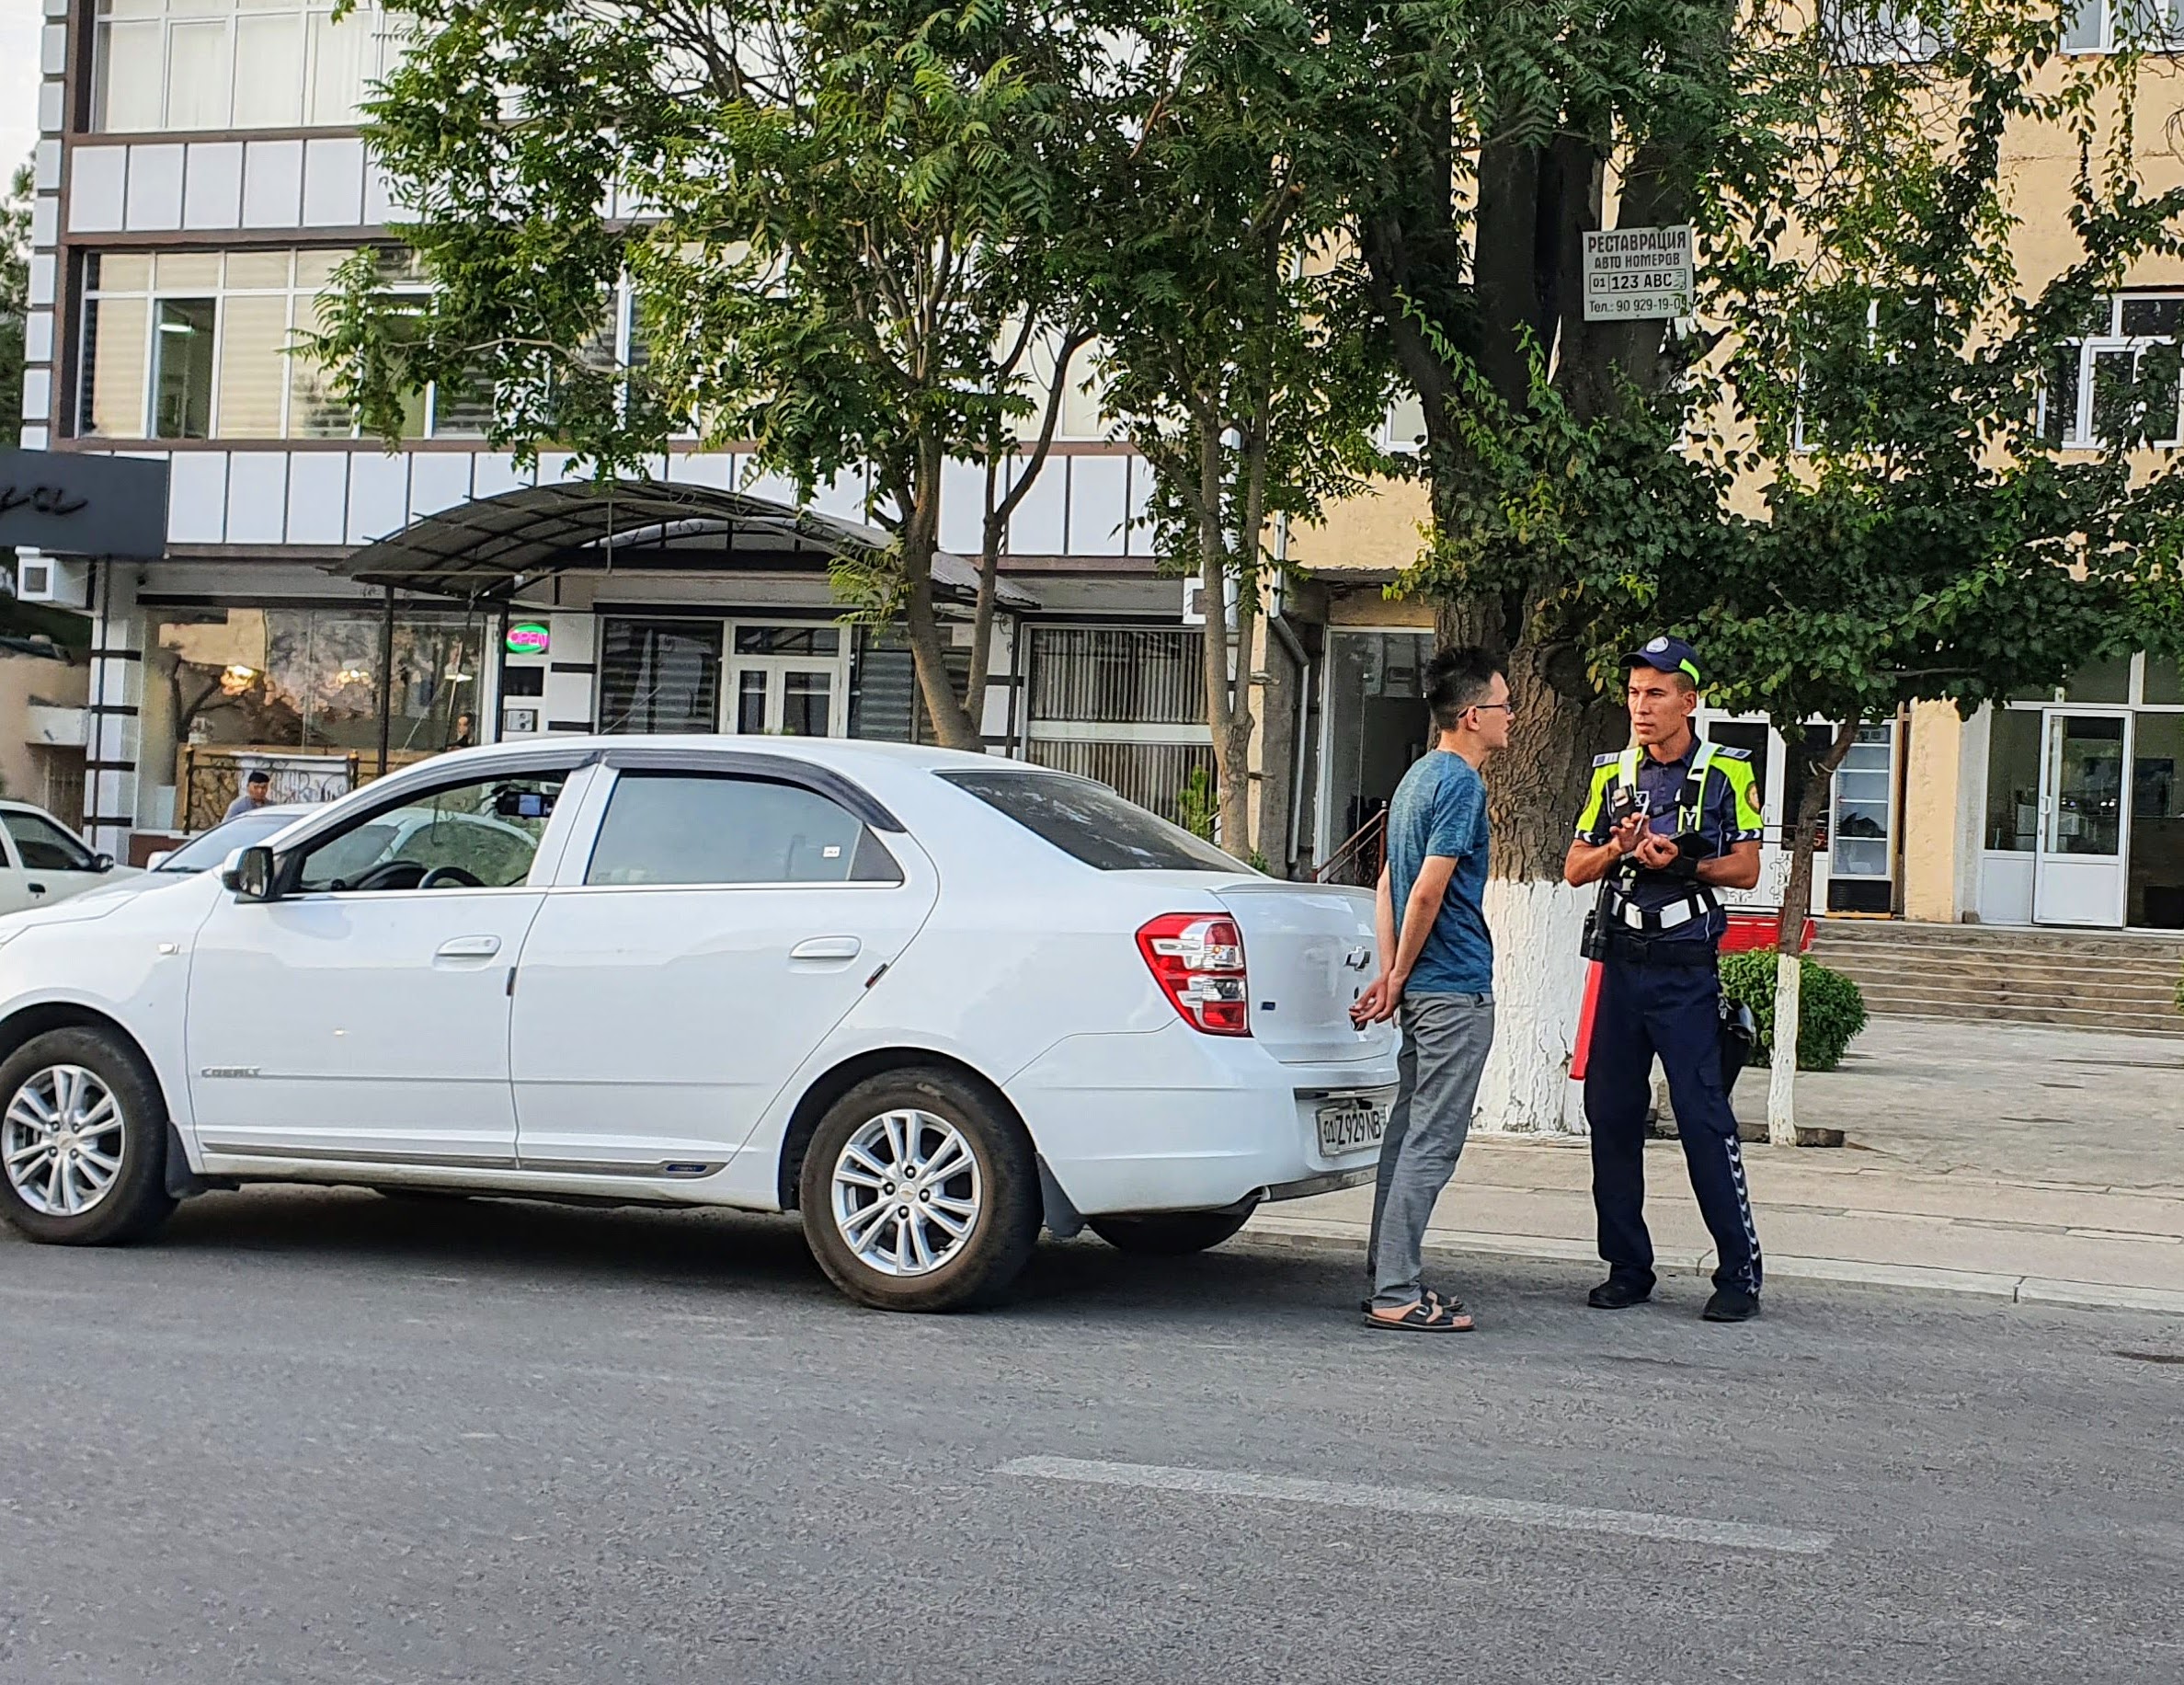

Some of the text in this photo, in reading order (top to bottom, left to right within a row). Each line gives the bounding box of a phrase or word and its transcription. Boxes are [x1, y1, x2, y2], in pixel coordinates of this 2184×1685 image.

[1587, 231, 1687, 253] РЕСТАВРАЦИЯ
[1595, 253, 1680, 269] АВТО НОМЕРОВ
[1593, 278, 1606, 288] 01
[1611, 275, 1639, 290] 123
[1617, 300, 1630, 312] 90
[509, 631, 549, 648] OPEN
